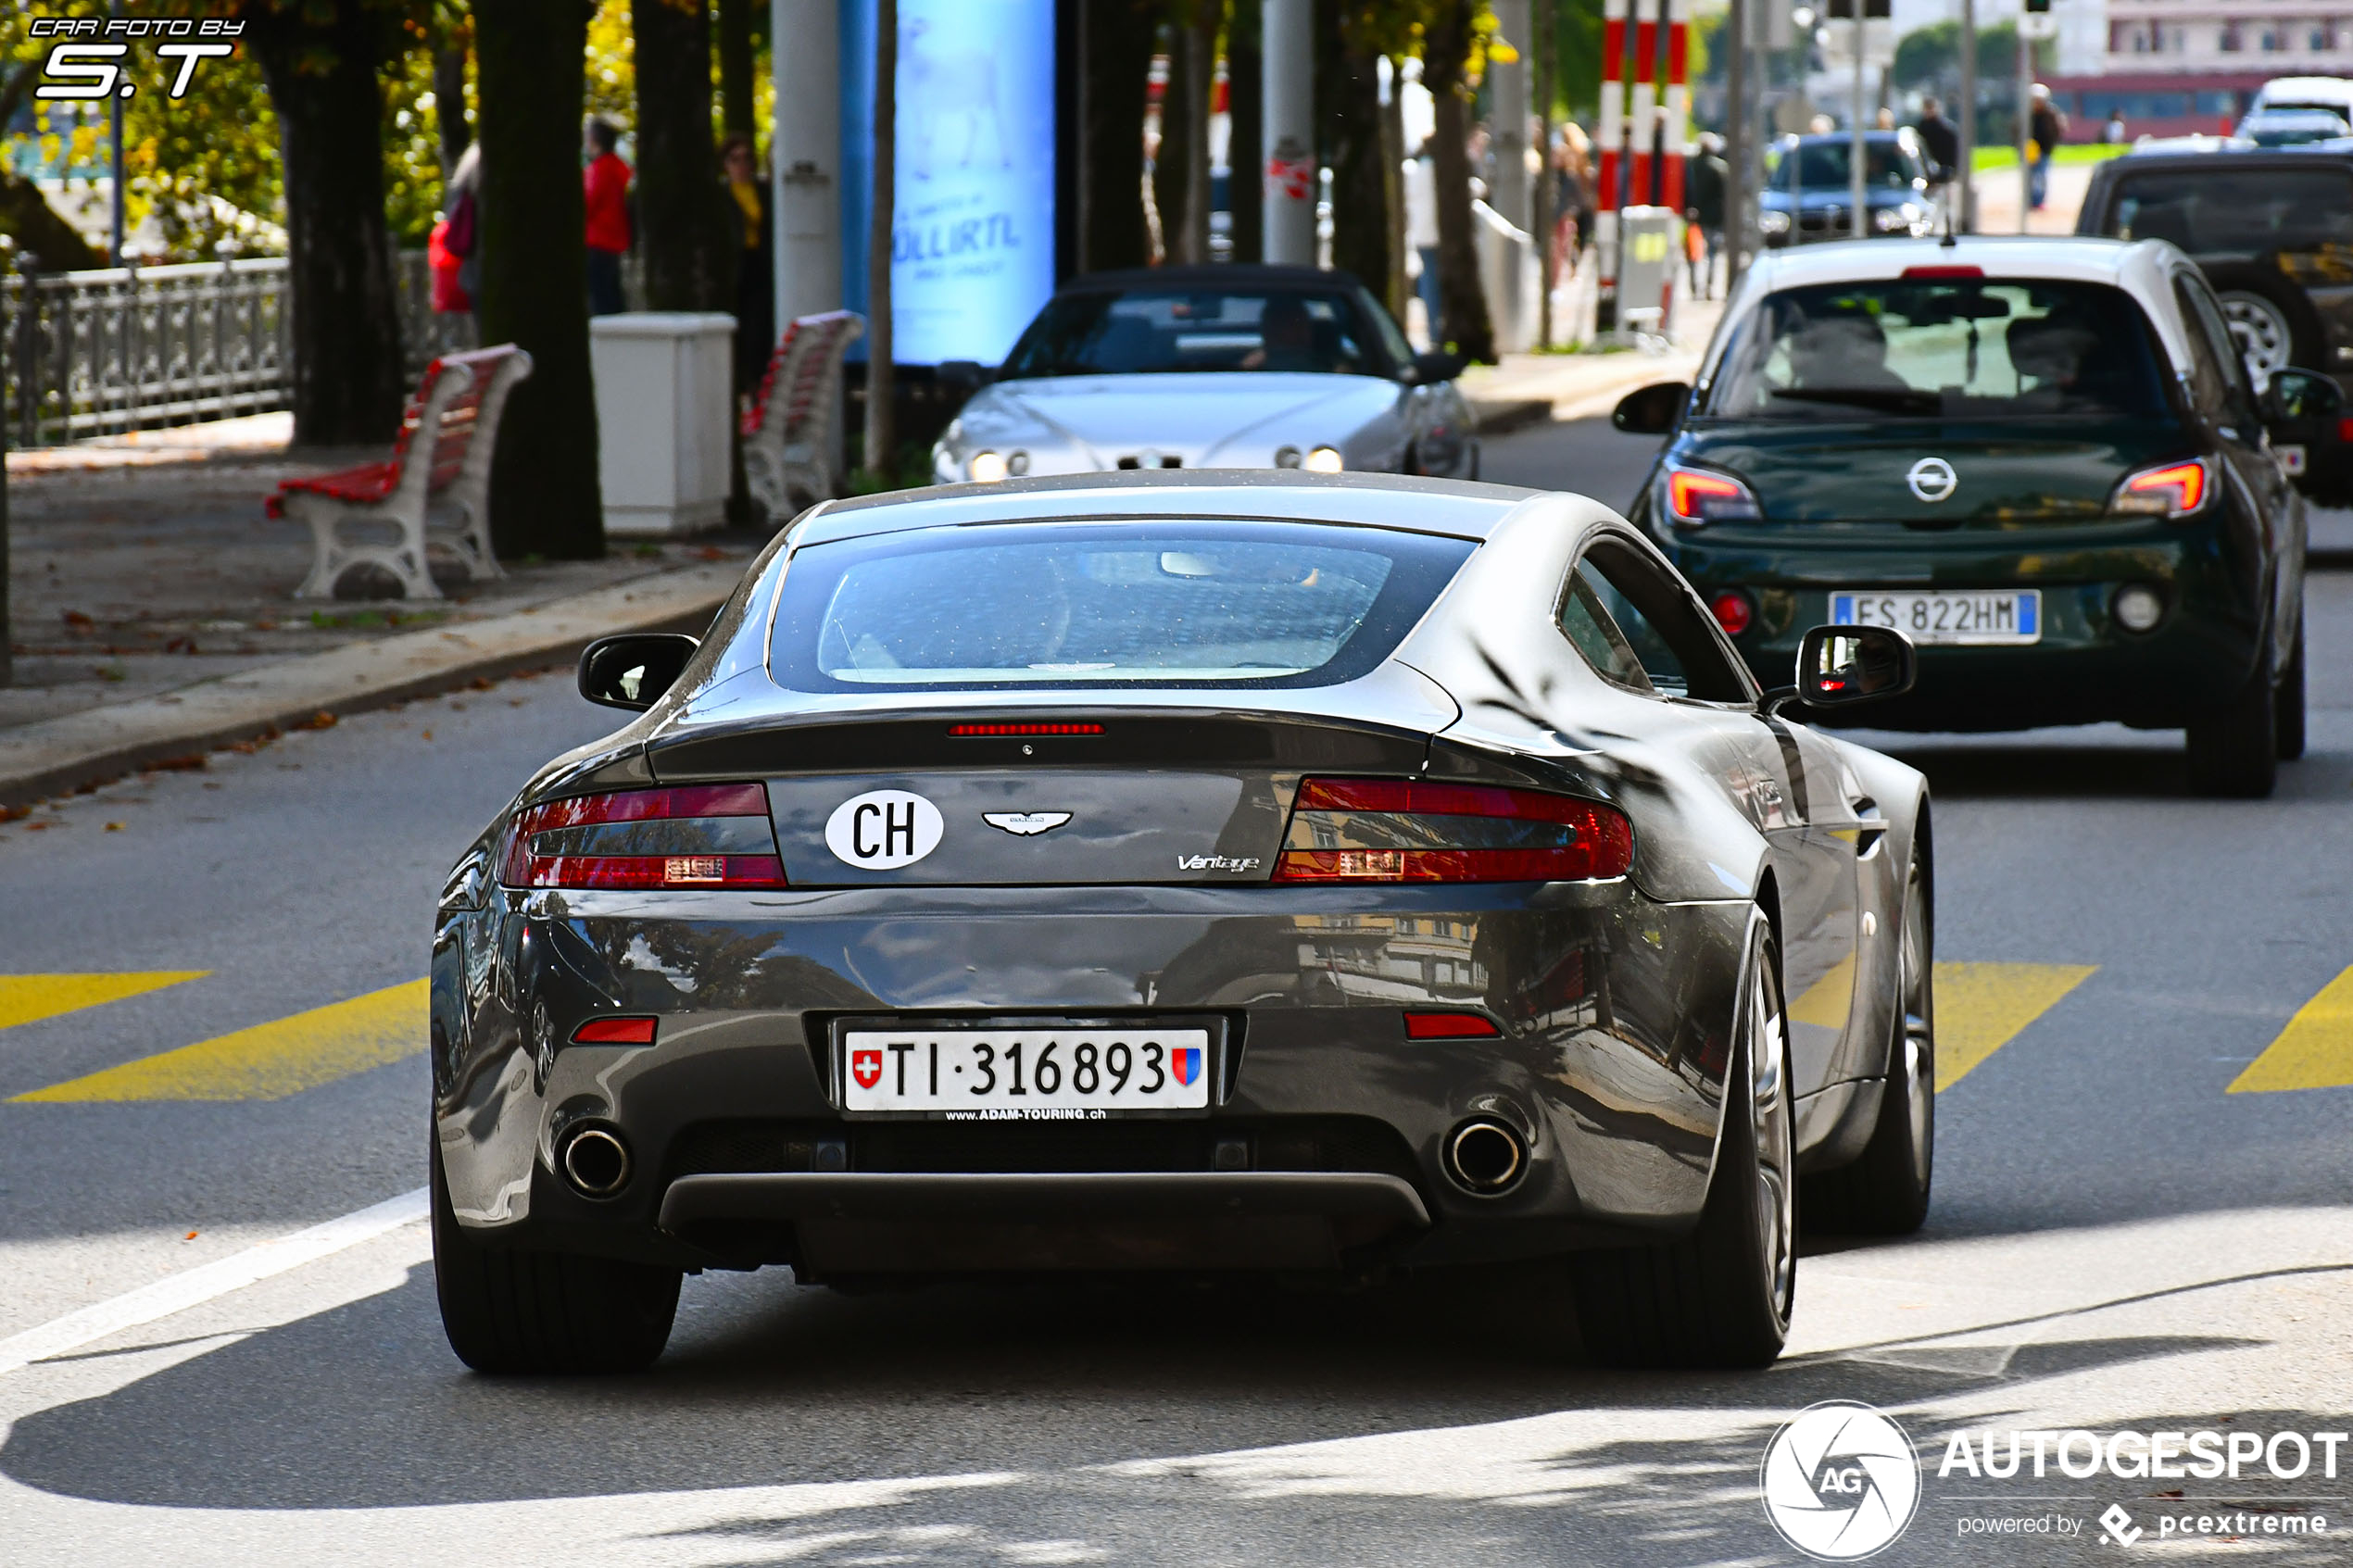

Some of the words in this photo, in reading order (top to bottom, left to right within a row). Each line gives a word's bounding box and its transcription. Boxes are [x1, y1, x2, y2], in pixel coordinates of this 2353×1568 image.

[1911, 599, 2013, 631] 822HM
[853, 801, 914, 859] CH
[1177, 854, 1260, 872] Vantage
[945, 1108, 1106, 1121] www.ADAM-TOURING.ch
